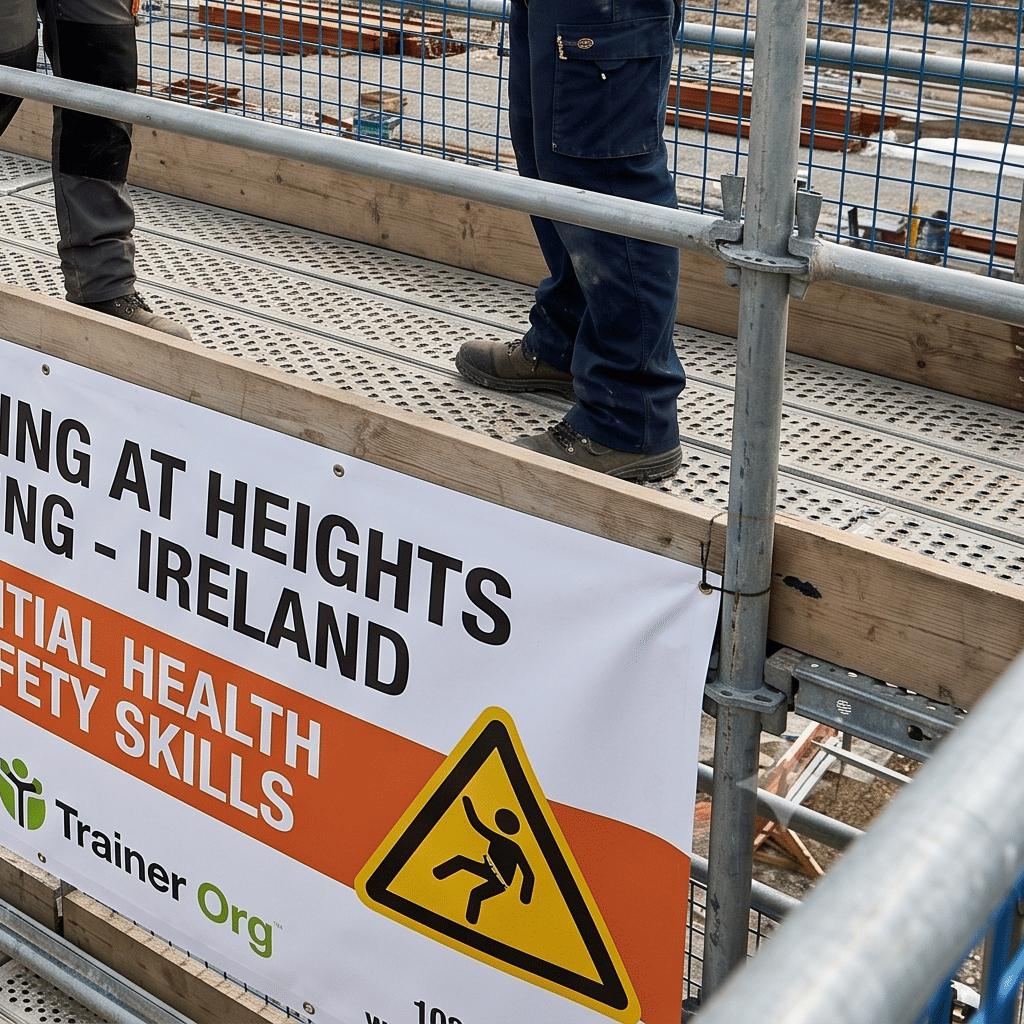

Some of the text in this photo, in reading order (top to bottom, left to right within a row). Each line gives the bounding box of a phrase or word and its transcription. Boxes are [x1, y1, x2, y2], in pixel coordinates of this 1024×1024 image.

[109, 440, 187, 521] AT
[206, 470, 513, 646] HEIGHTS
[137, 529, 411, 696] IRELAND
[115, 700, 295, 833] SKILLS
[123, 636, 321, 780] HEALTH
[55, 798, 273, 959] Trainer Org
